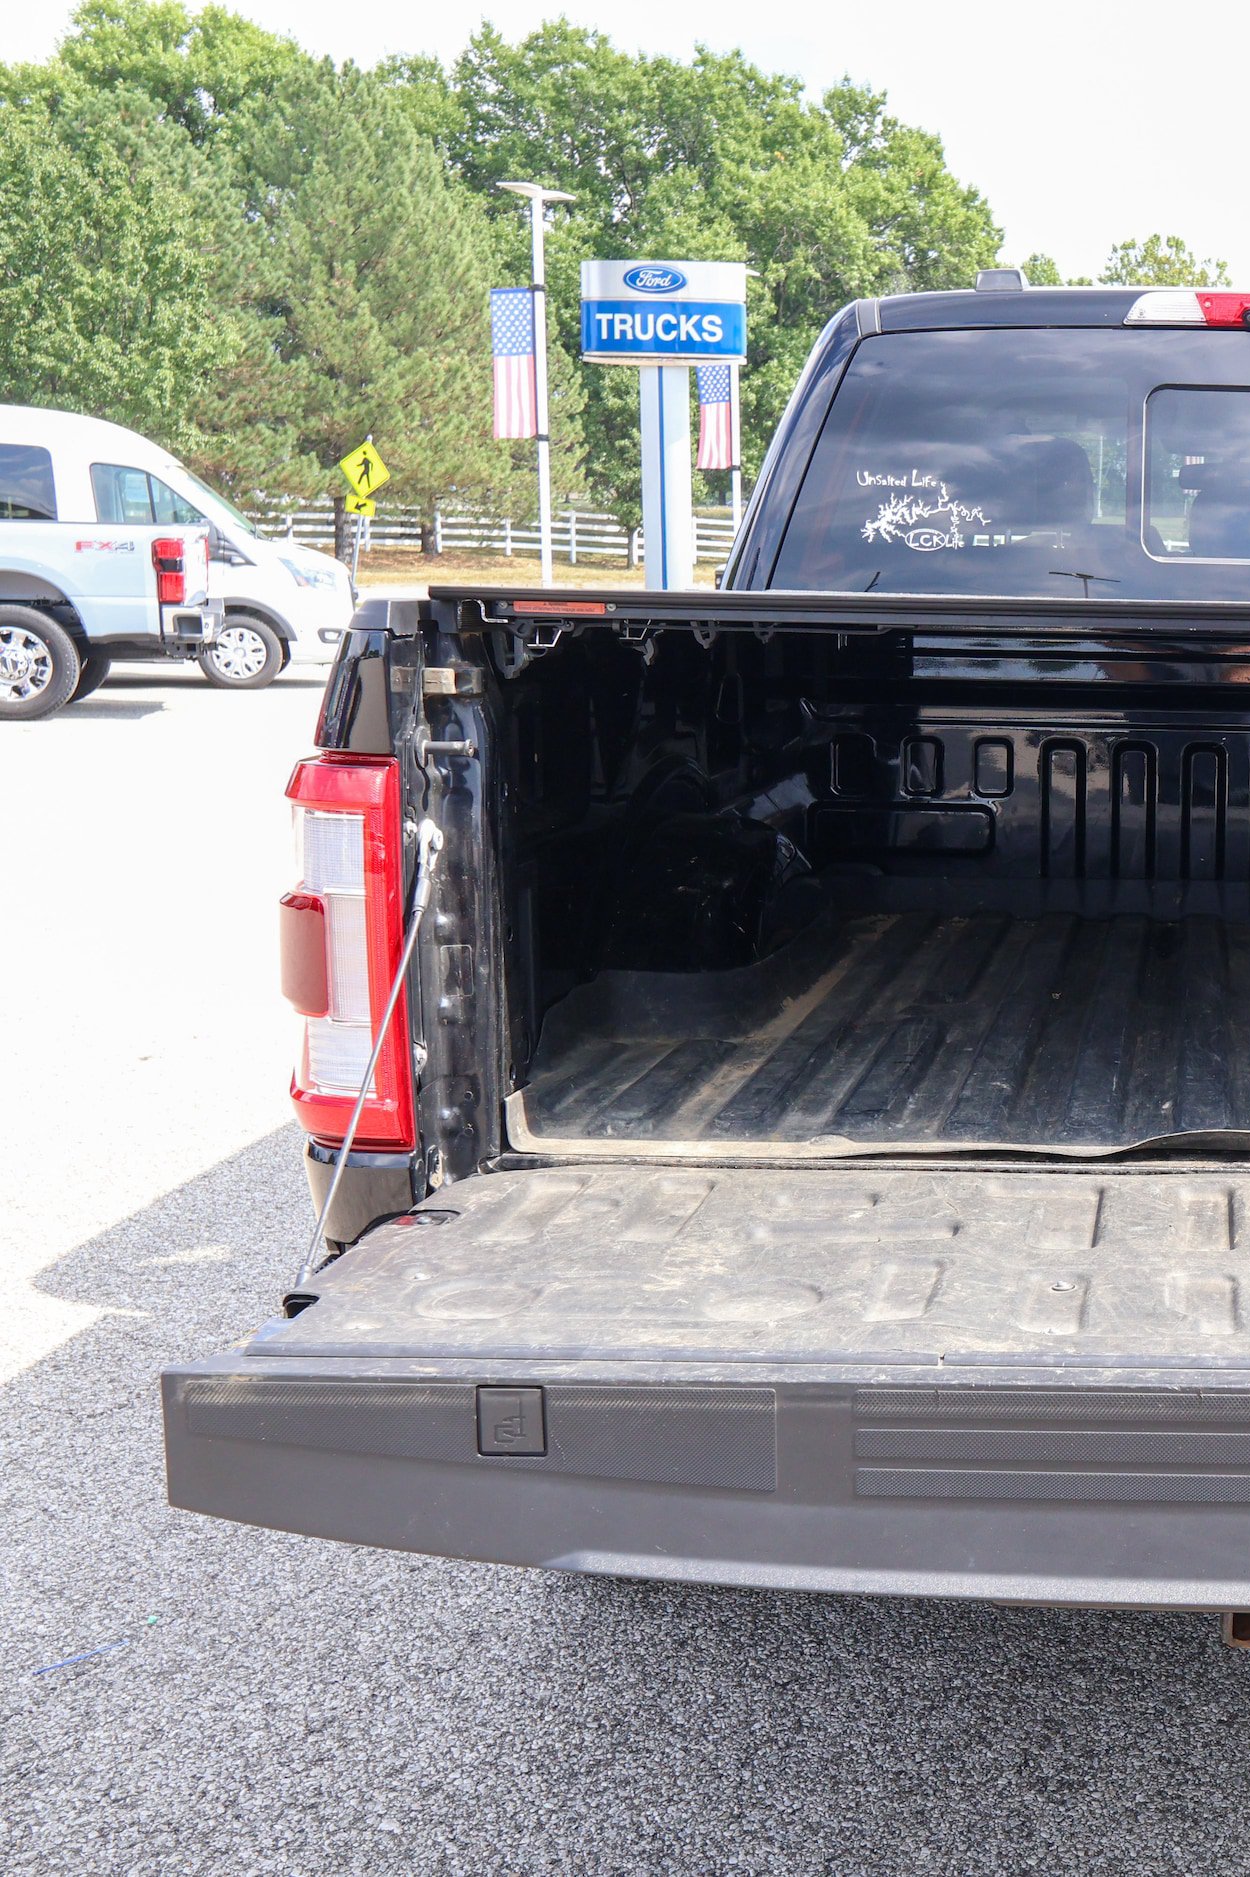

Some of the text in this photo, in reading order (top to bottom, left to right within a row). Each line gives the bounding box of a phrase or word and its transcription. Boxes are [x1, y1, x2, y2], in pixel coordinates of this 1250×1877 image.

[636, 269, 673, 287] Ford
[595, 313, 723, 343] TRUCKS
[75, 541, 135, 552] FX4
